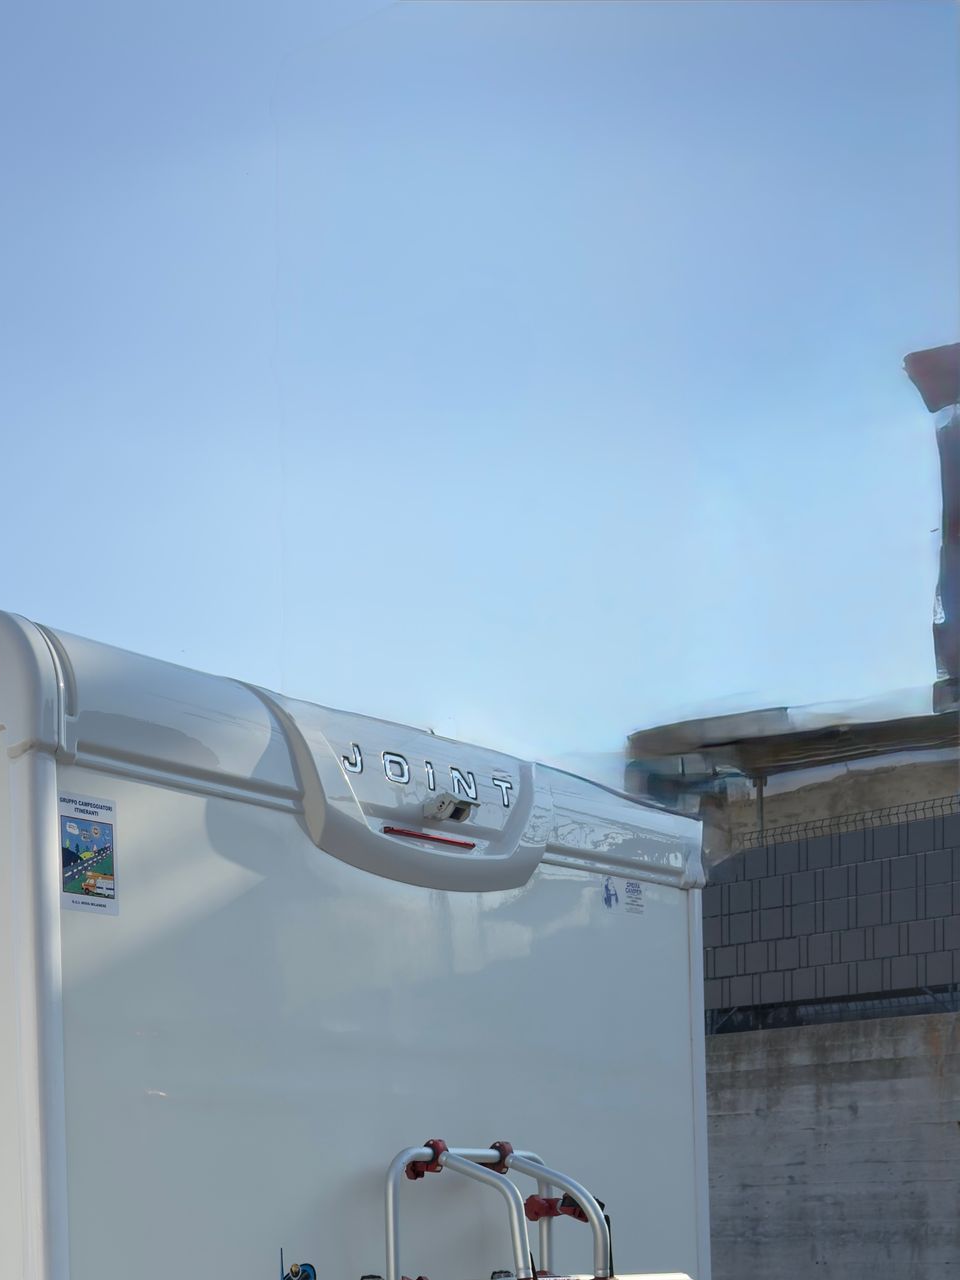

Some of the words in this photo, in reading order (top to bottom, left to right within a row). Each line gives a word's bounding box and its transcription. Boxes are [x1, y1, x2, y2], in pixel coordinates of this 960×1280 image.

[341, 743, 512, 807] JOINT
[59, 797, 78, 806] GRUPPO
[78, 800, 113, 812] CAMPEGGIATORI
[74, 807, 99, 816] ITINERANTI
